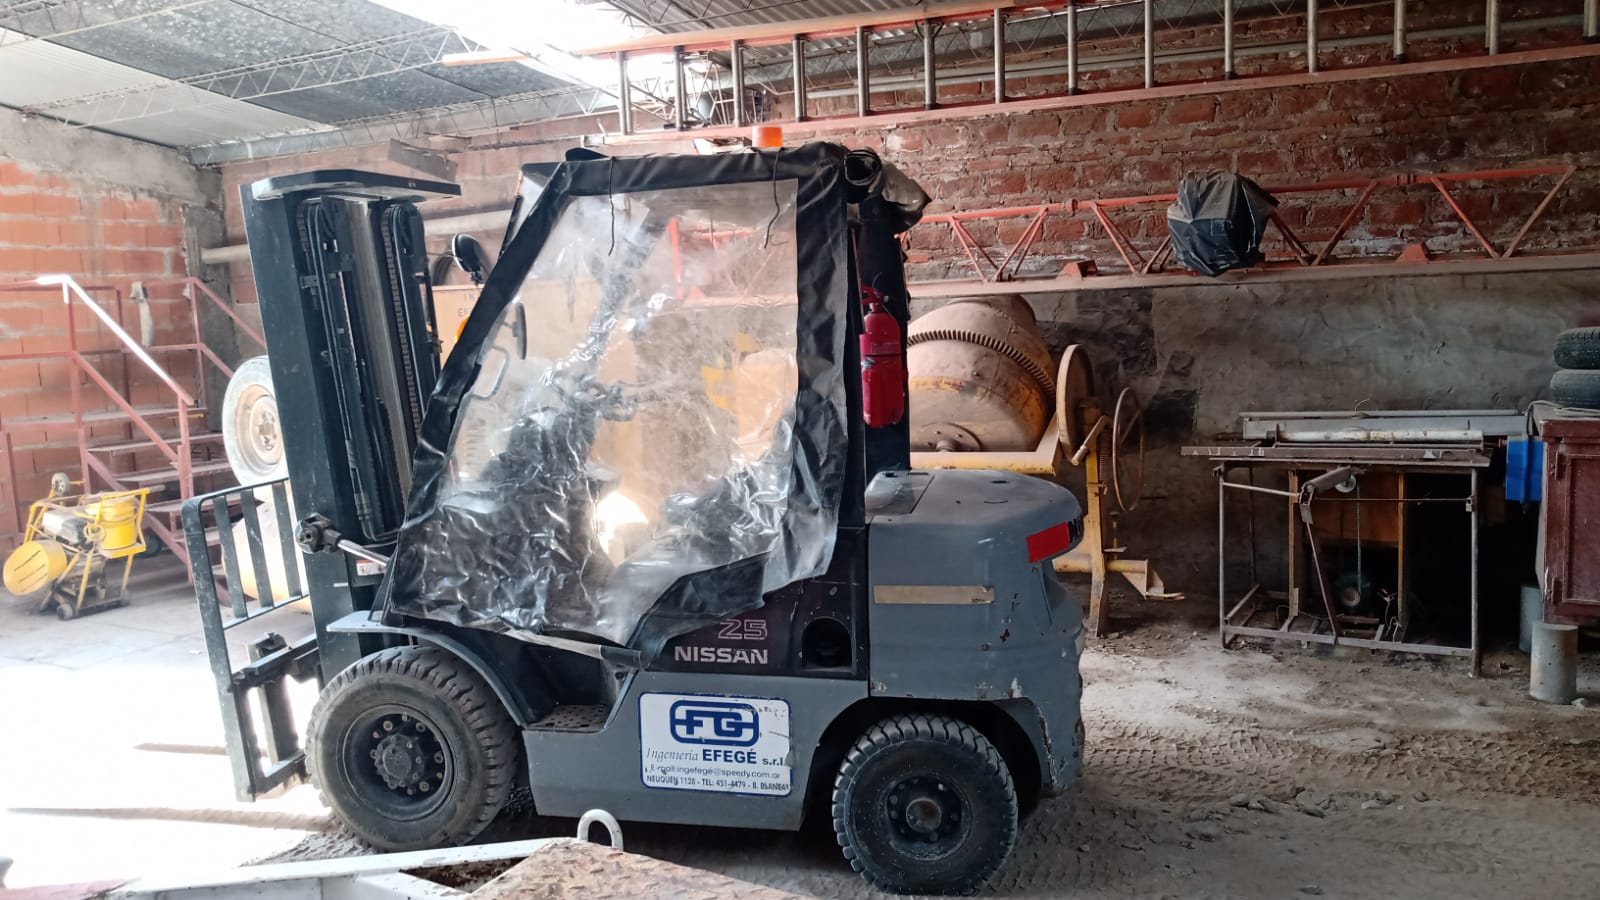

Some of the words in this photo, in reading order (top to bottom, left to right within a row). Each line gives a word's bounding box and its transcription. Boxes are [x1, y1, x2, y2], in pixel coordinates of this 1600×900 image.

[718, 618, 768, 640] 25
[674, 646, 768, 664] NISSAN
[702, 749, 757, 764] EFEGÉ
